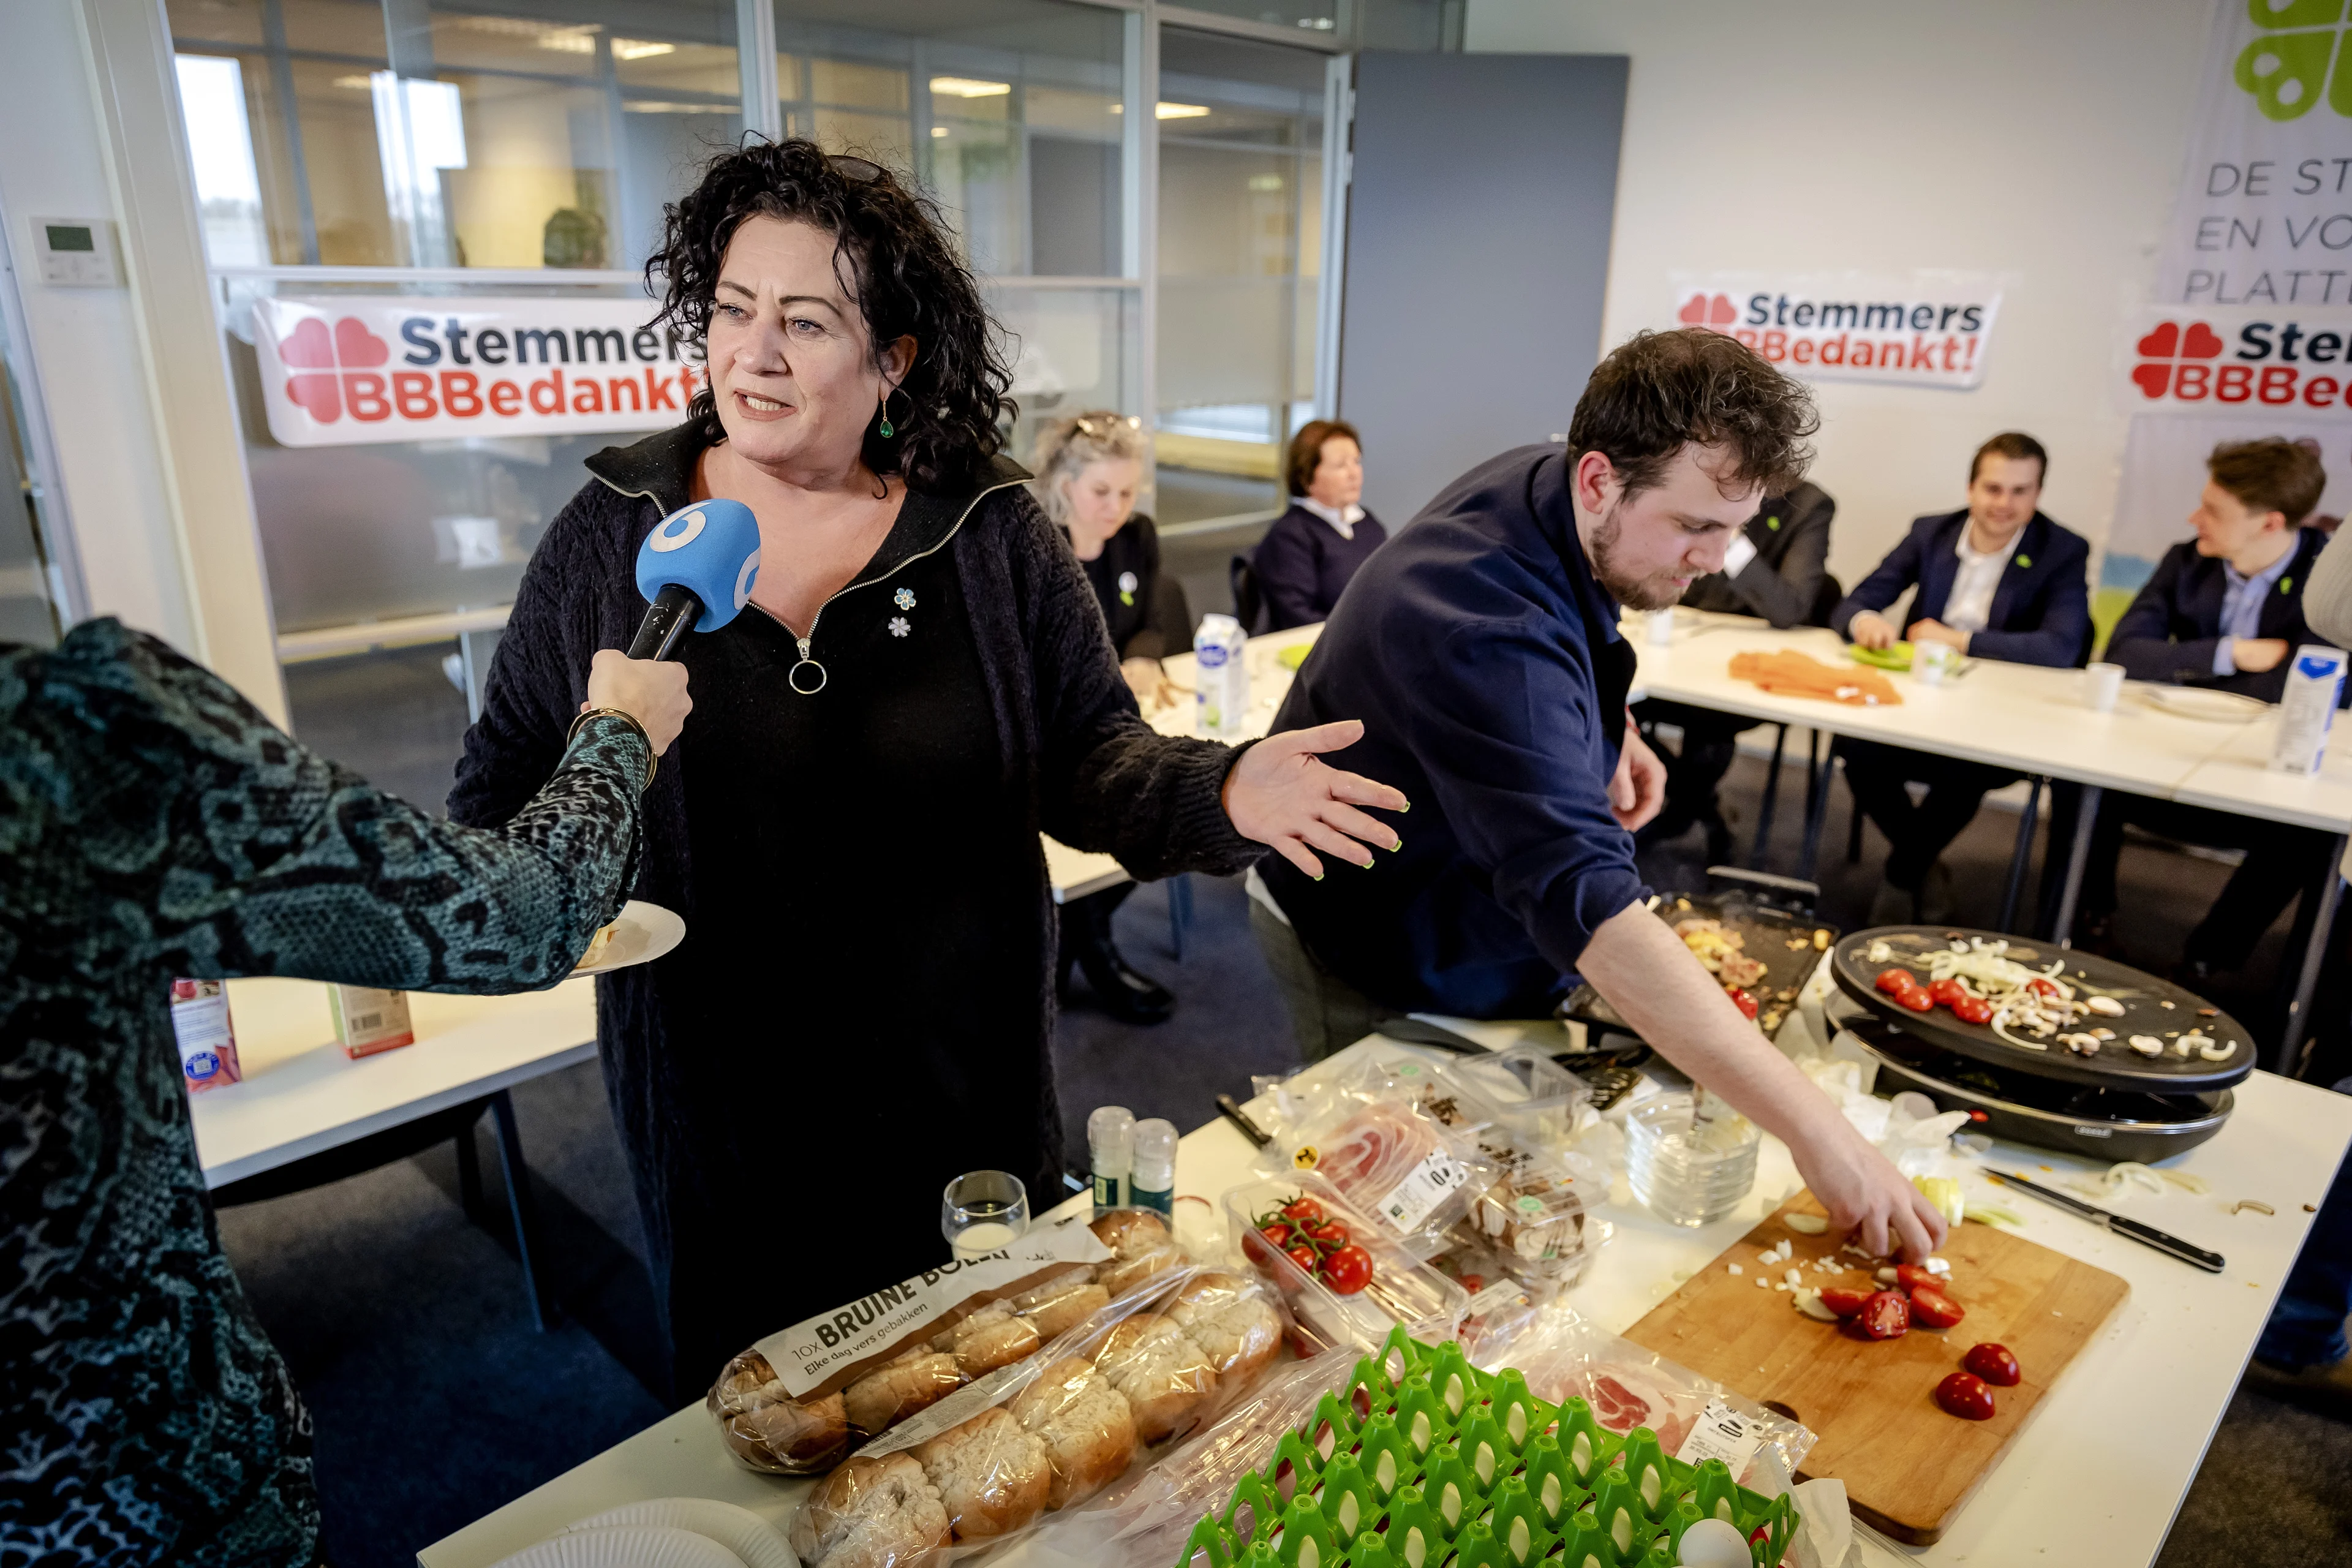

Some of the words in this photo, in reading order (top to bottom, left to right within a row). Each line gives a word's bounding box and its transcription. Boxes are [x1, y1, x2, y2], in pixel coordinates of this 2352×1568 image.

[2206, 161, 2275, 197] DE
[2195, 216, 2263, 251] EN
[2285, 213, 2352, 251] VO
[2182, 269, 2352, 306] PLATT
[1746, 293, 1985, 333] Stemmers
[1719, 328, 1978, 373] BBedankt!
[2235, 321, 2352, 363] Ste
[2173, 363, 2352, 409] BBBe
[815, 1279, 918, 1348] BRUINE
[804, 1356, 830, 1376] Elke
[831, 1346, 853, 1362] dag
[853, 1335, 876, 1352] vers
[877, 1302, 929, 1340] gebakken
